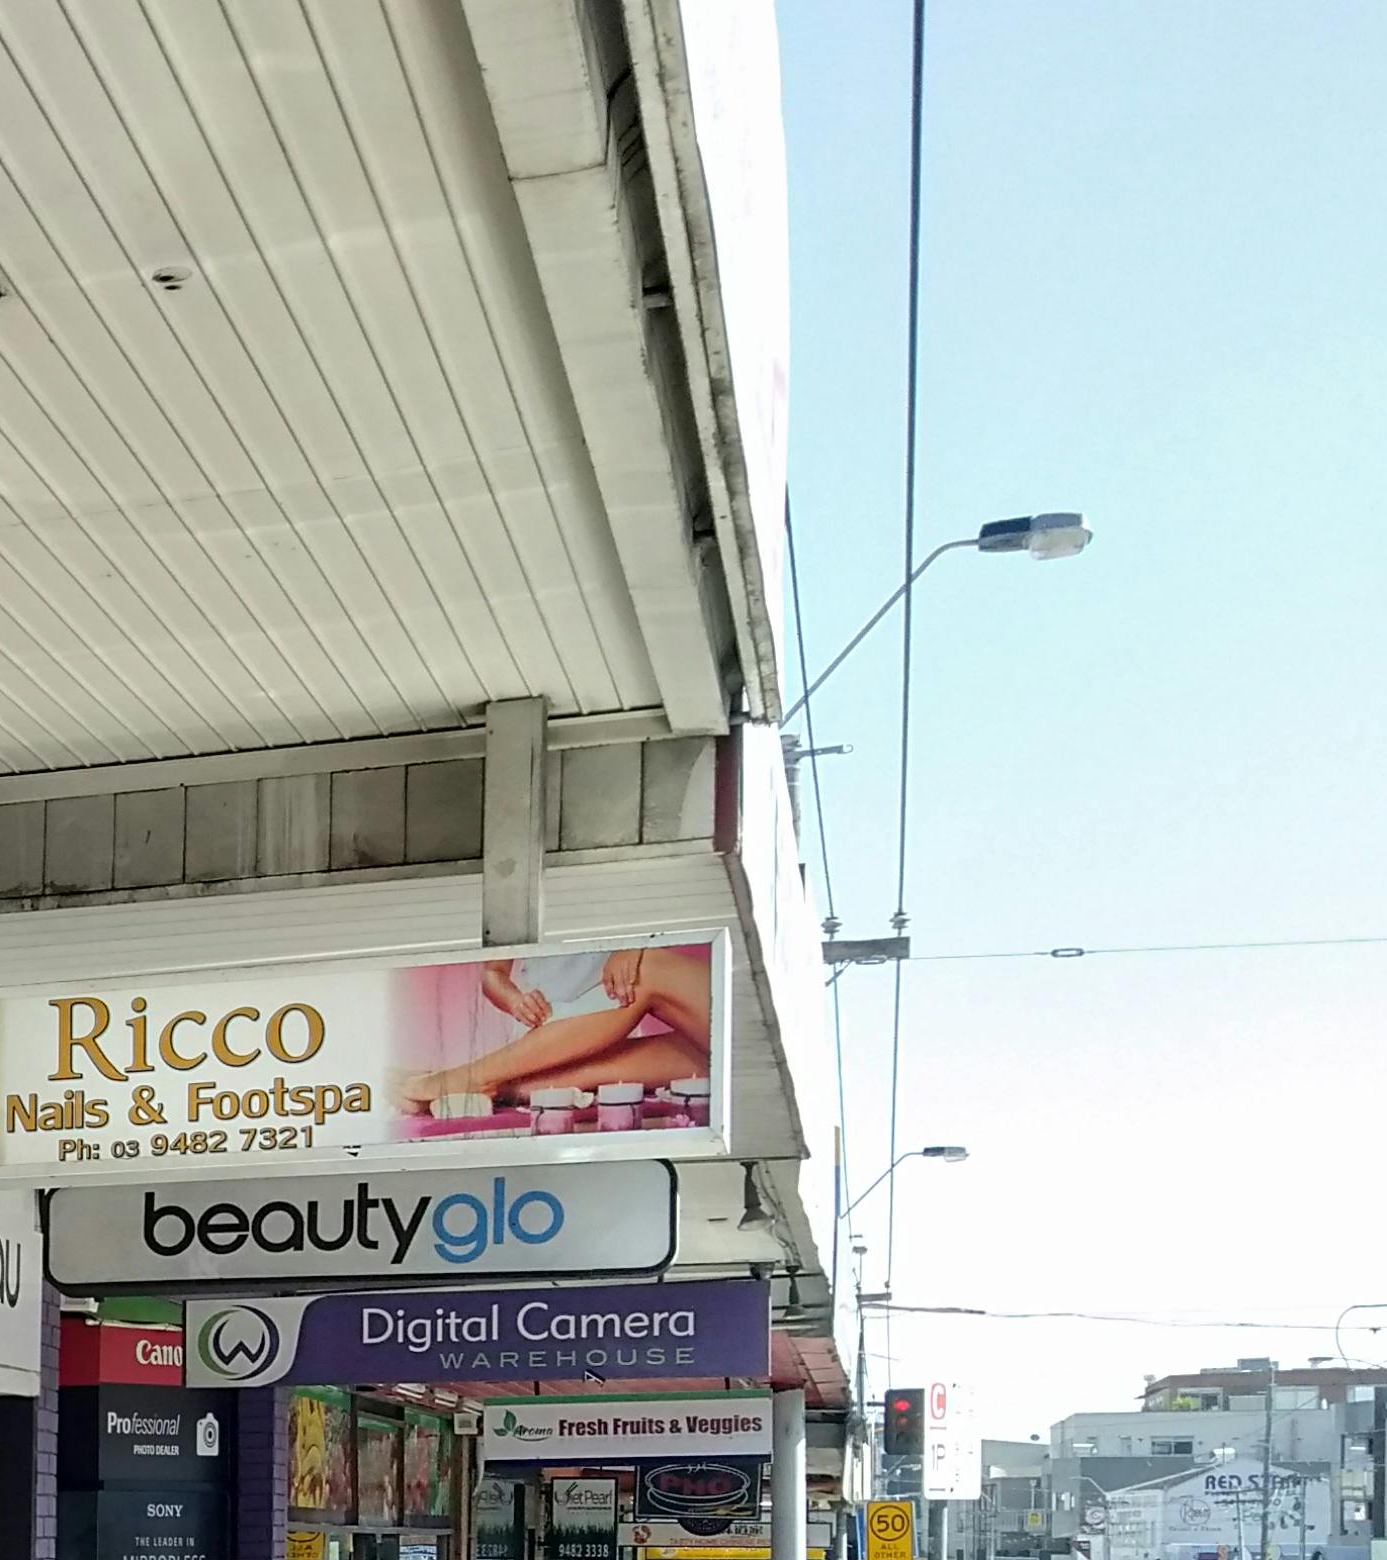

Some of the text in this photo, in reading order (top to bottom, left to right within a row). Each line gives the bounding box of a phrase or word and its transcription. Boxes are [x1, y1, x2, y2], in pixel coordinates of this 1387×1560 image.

[48, 997, 325, 1081] Ricco
[6, 1077, 370, 1132] Nails & Footspa
[58, 1126, 314, 1162] Ph: 03 9482 7321
[144, 1177, 565, 1265] beautyglo
[362, 1302, 695, 1352] Digital Camera
[136, 1339, 182, 1366] Cano
[439, 1347, 696, 1369] WAREHOUSE
[107, 1411, 180, 1439] Professional
[558, 1417, 609, 1437] Fresh
[613, 1415, 665, 1435] Fruits
[669, 1416, 682, 1434] &
[685, 1414, 763, 1436] Veggies
[133, 1445, 180, 1456] PHOTO DEALER
[147, 1504, 183, 1518] SONY
[876, 1513, 905, 1532] 50
[135, 1536, 183, 1547] THE LEADER
[585, 1544, 609, 1557] 3338
